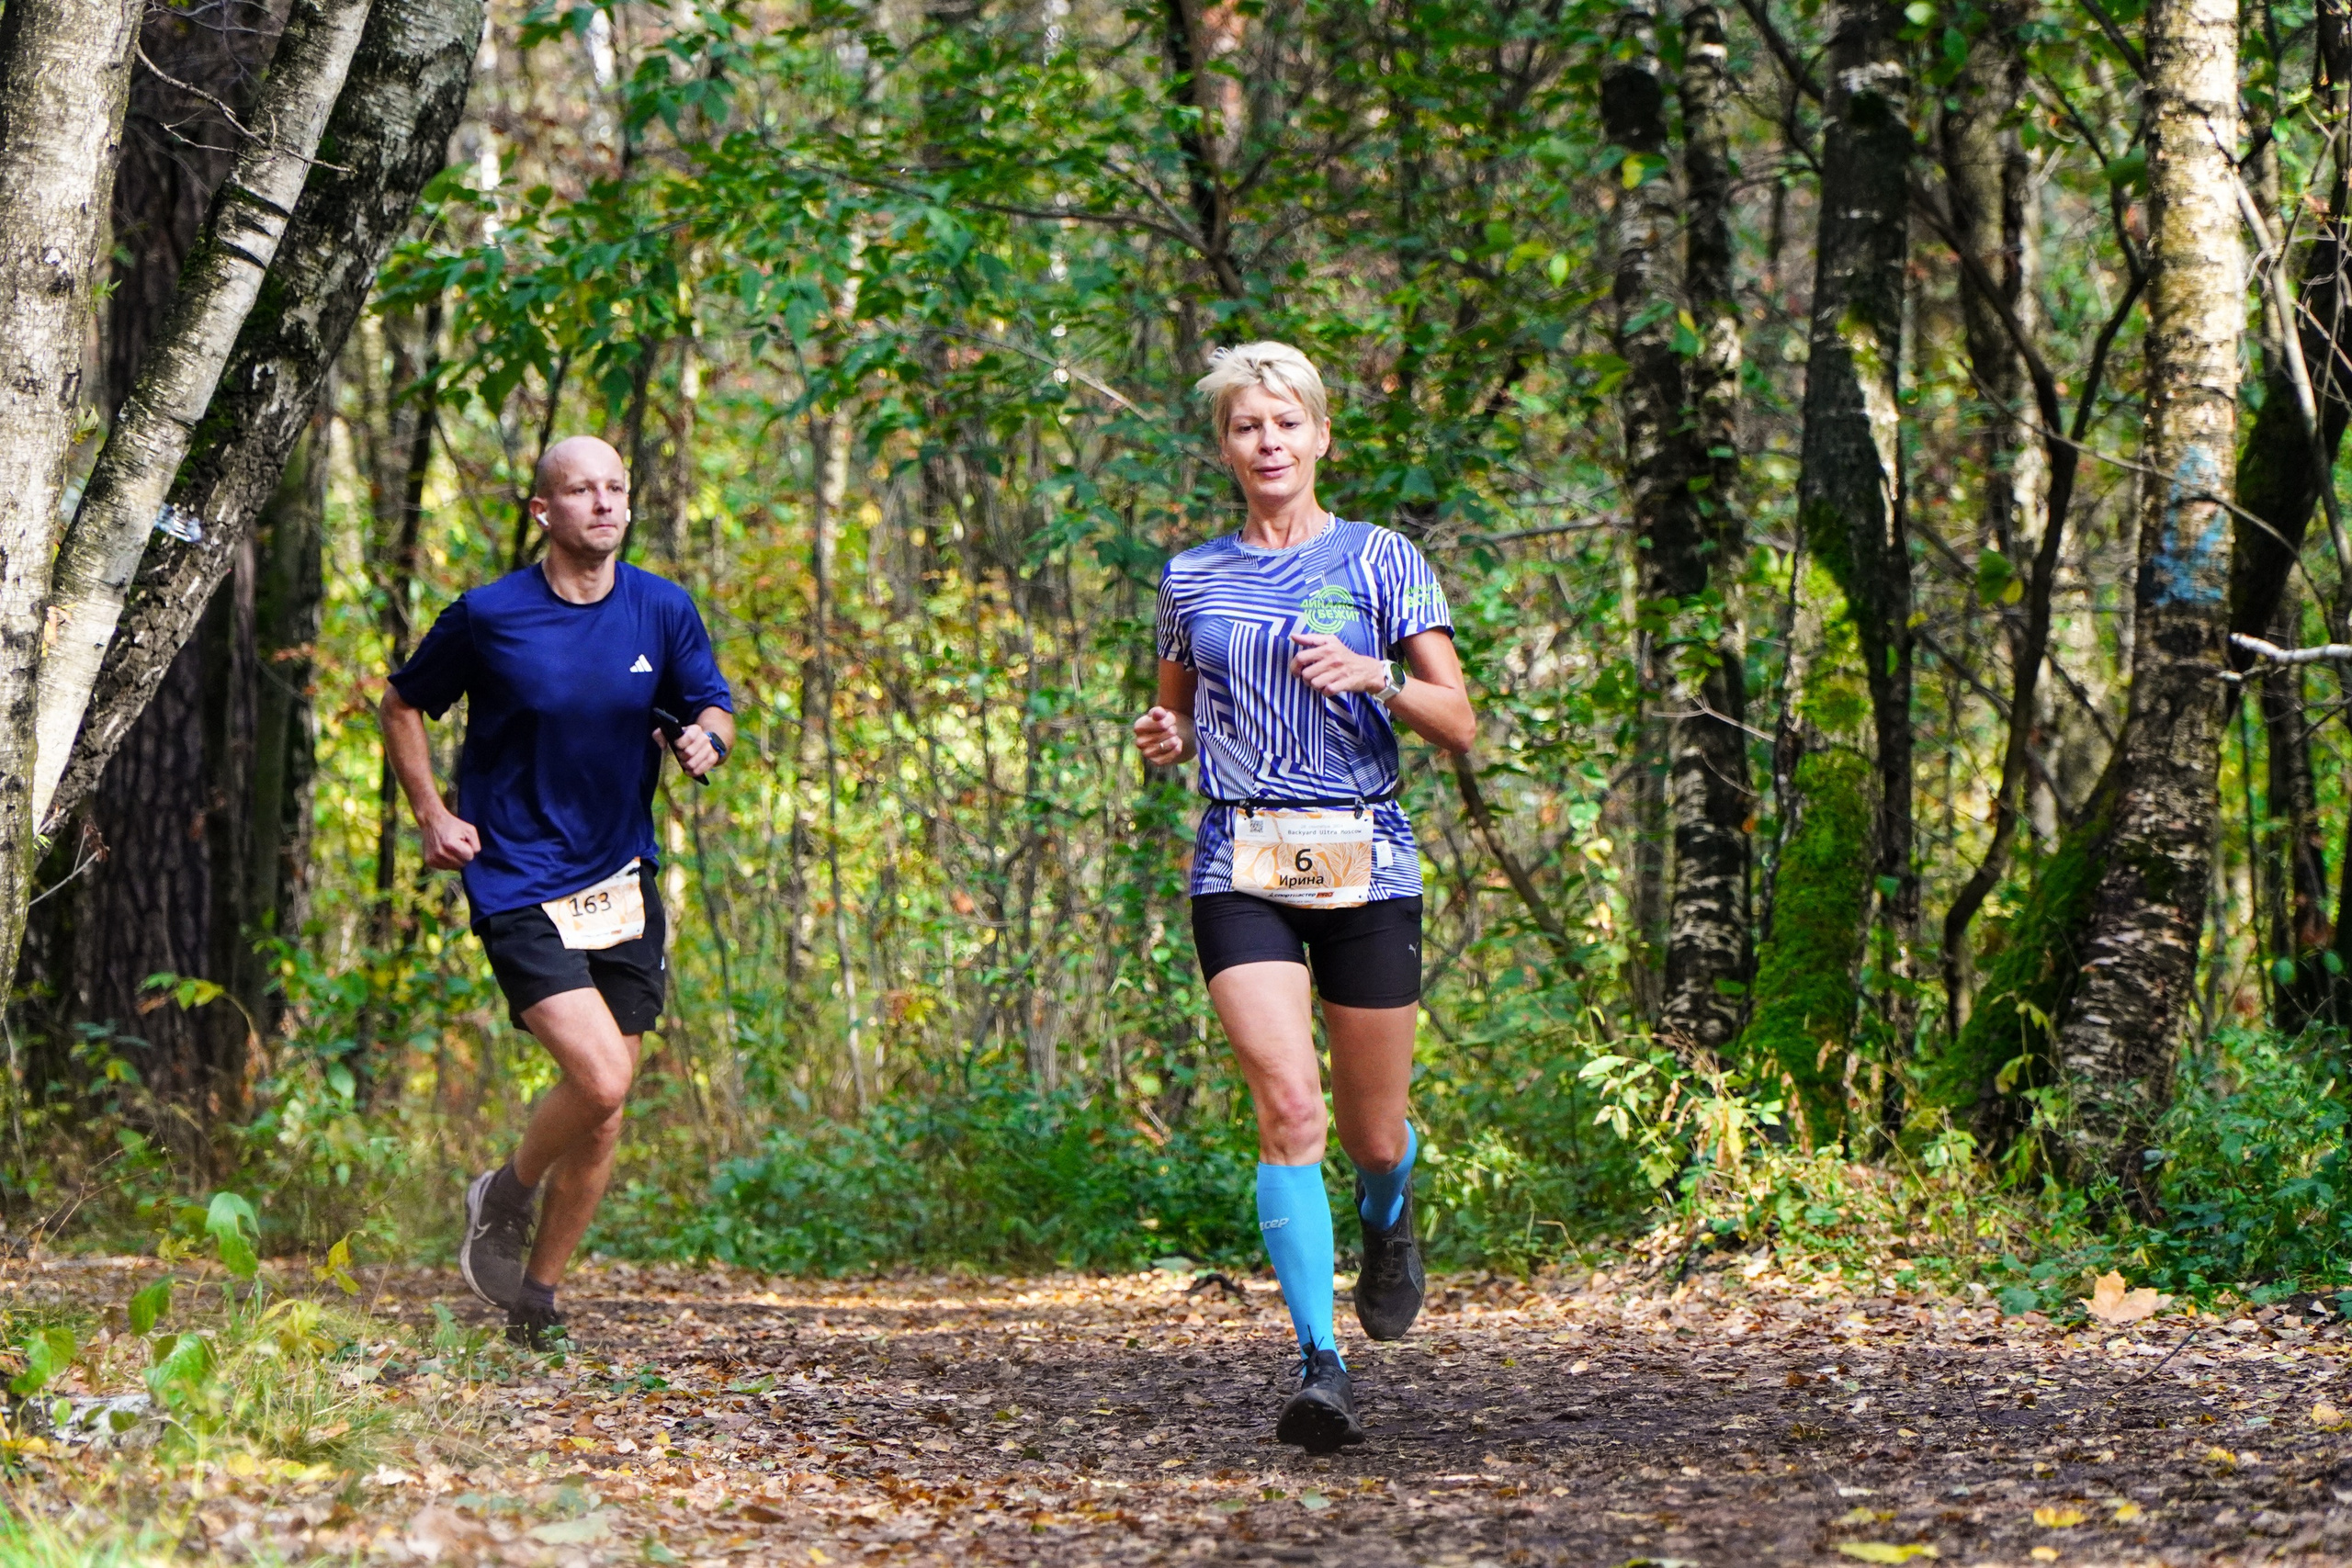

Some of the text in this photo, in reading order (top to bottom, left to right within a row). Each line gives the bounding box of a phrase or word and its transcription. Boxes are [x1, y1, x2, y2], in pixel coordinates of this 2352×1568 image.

[1299, 598, 1354, 610] ДИНАМО
[1317, 609, 1360, 622] БЕЖИТ
[1295, 848, 1313, 872] 6
[1279, 874, 1324, 889] Ирина
[570, 892, 611, 917] 163
